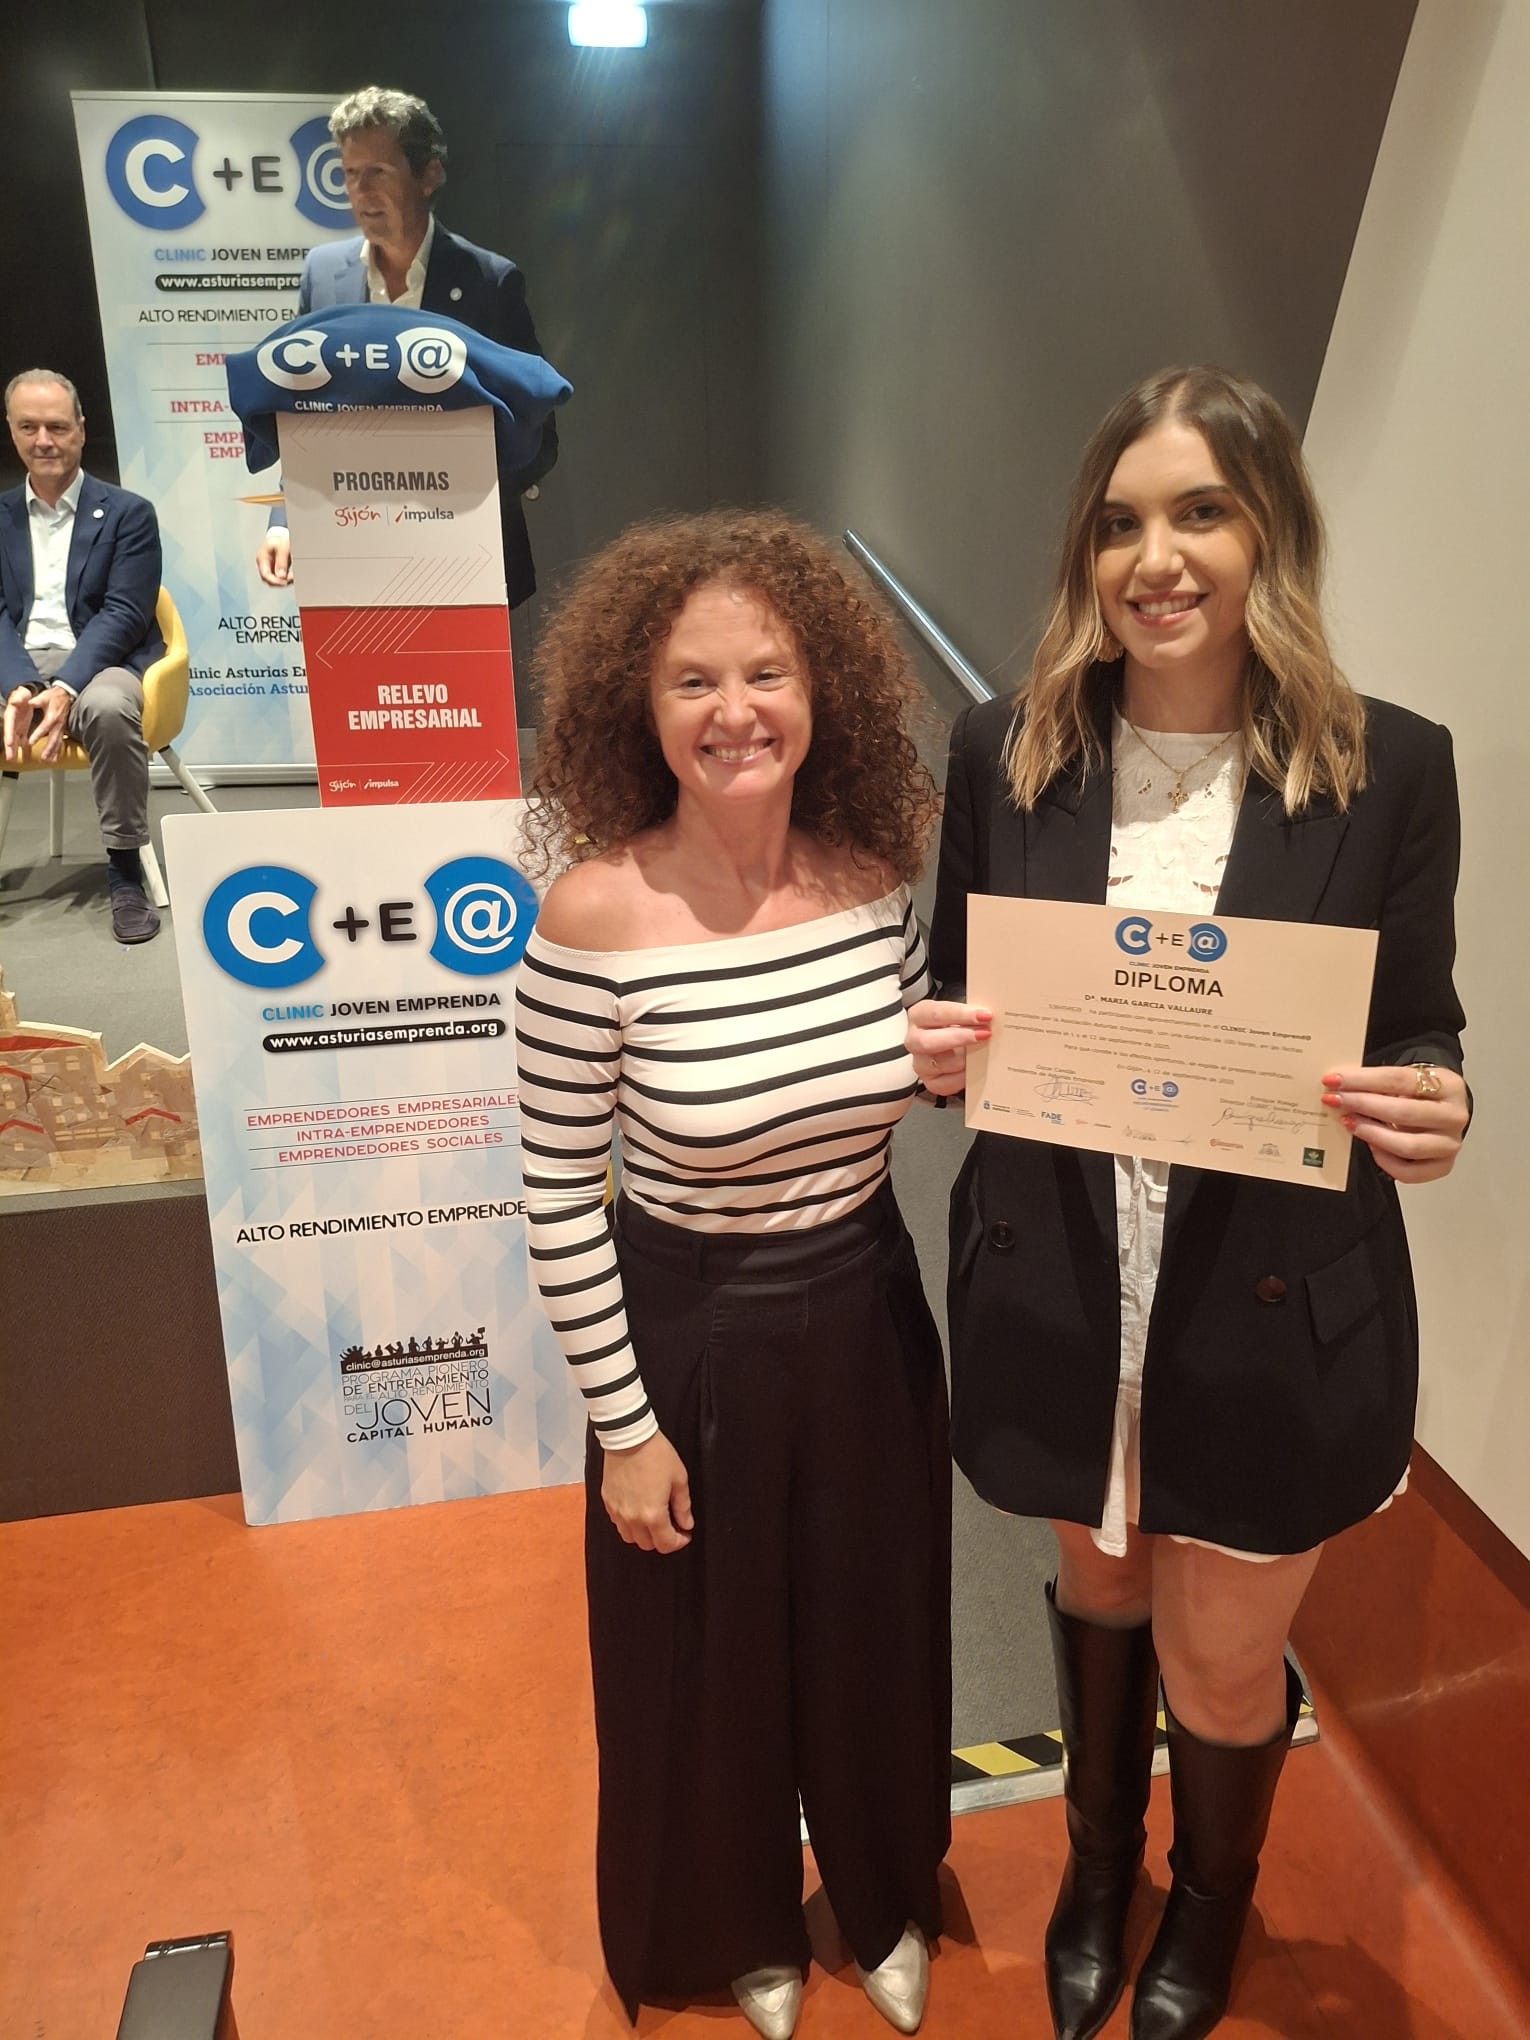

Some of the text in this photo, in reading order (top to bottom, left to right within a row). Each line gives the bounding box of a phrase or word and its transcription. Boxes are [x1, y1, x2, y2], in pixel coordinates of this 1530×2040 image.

[125, 139, 190, 207] C
[155, 249, 206, 261] CLINIC
[211, 248, 261, 261] JOVEN
[139, 309, 174, 322] ALTO
[178, 308, 277, 322] RENDIMIENTO
[295, 400, 333, 412] CLINIC
[333, 471, 449, 491] PROGRAMAS
[400, 505, 454, 523] impulsa
[218, 616, 257, 630] ALTO
[236, 630, 302, 643] EMPREN
[225, 666, 289, 679] Asturias
[377, 684, 449, 705] RELEVO
[348, 708, 482, 731] EMPRESARIAL
[227, 891, 305, 964] C
[444, 883, 518, 954] @
[1115, 969, 1224, 997] DIPLOMA
[262, 993, 501, 1021] CLINIC JOVEN EMPRENDA
[1100, 996, 1129, 1005] MARIA
[1131, 1000, 1165, 1010] GARCIA
[1168, 1004, 1213, 1015] VALLAURE
[269, 1021, 498, 1048] www.asturiasemprenda.org
[247, 1104, 390, 1127] EMPRENDEDORES
[297, 1115, 490, 1142] INTRA-EMPRENDEDORES
[278, 1132, 503, 1163] EMPRENDEDORES SOCIALES
[236, 1225, 285, 1244] ALTO
[290, 1211, 423, 1238] RENDIMIENTO
[345, 1348, 485, 1372] clinic@asturiasemprenda.org
[342, 1359, 489, 1386] PROGRAMA PIONERO
[343, 1370, 489, 1397] DE ENTRENAMIENTO
[380, 1389, 408, 1400] ALTO
[412, 1380, 489, 1396] RENDIMIENTO
[344, 1388, 491, 1430] DEL JOVEN
[347, 1416, 493, 1443] CAPITAL HUMANO
